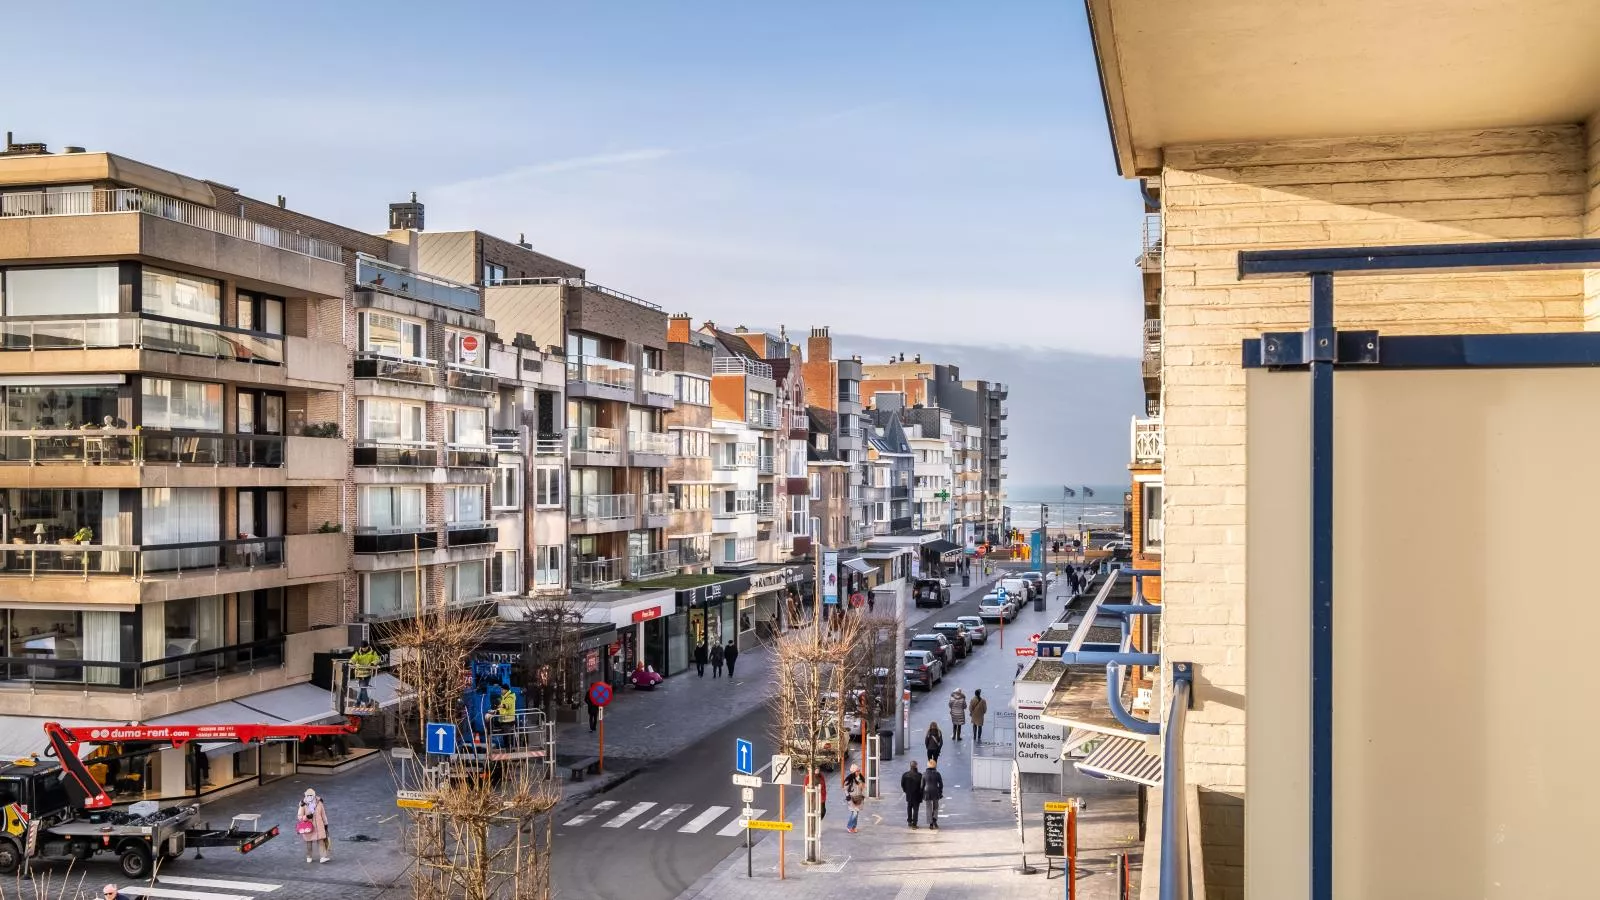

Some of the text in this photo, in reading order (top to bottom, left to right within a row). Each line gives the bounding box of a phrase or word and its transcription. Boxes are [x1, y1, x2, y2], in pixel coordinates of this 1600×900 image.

[999, 588, 1005, 597] P
[1018, 722, 1045, 730] Glaces
[1018, 732, 1061, 741] Milkshakes
[1018, 742, 1045, 750] Wafels
[1018, 751, 1049, 760] Gaufres
